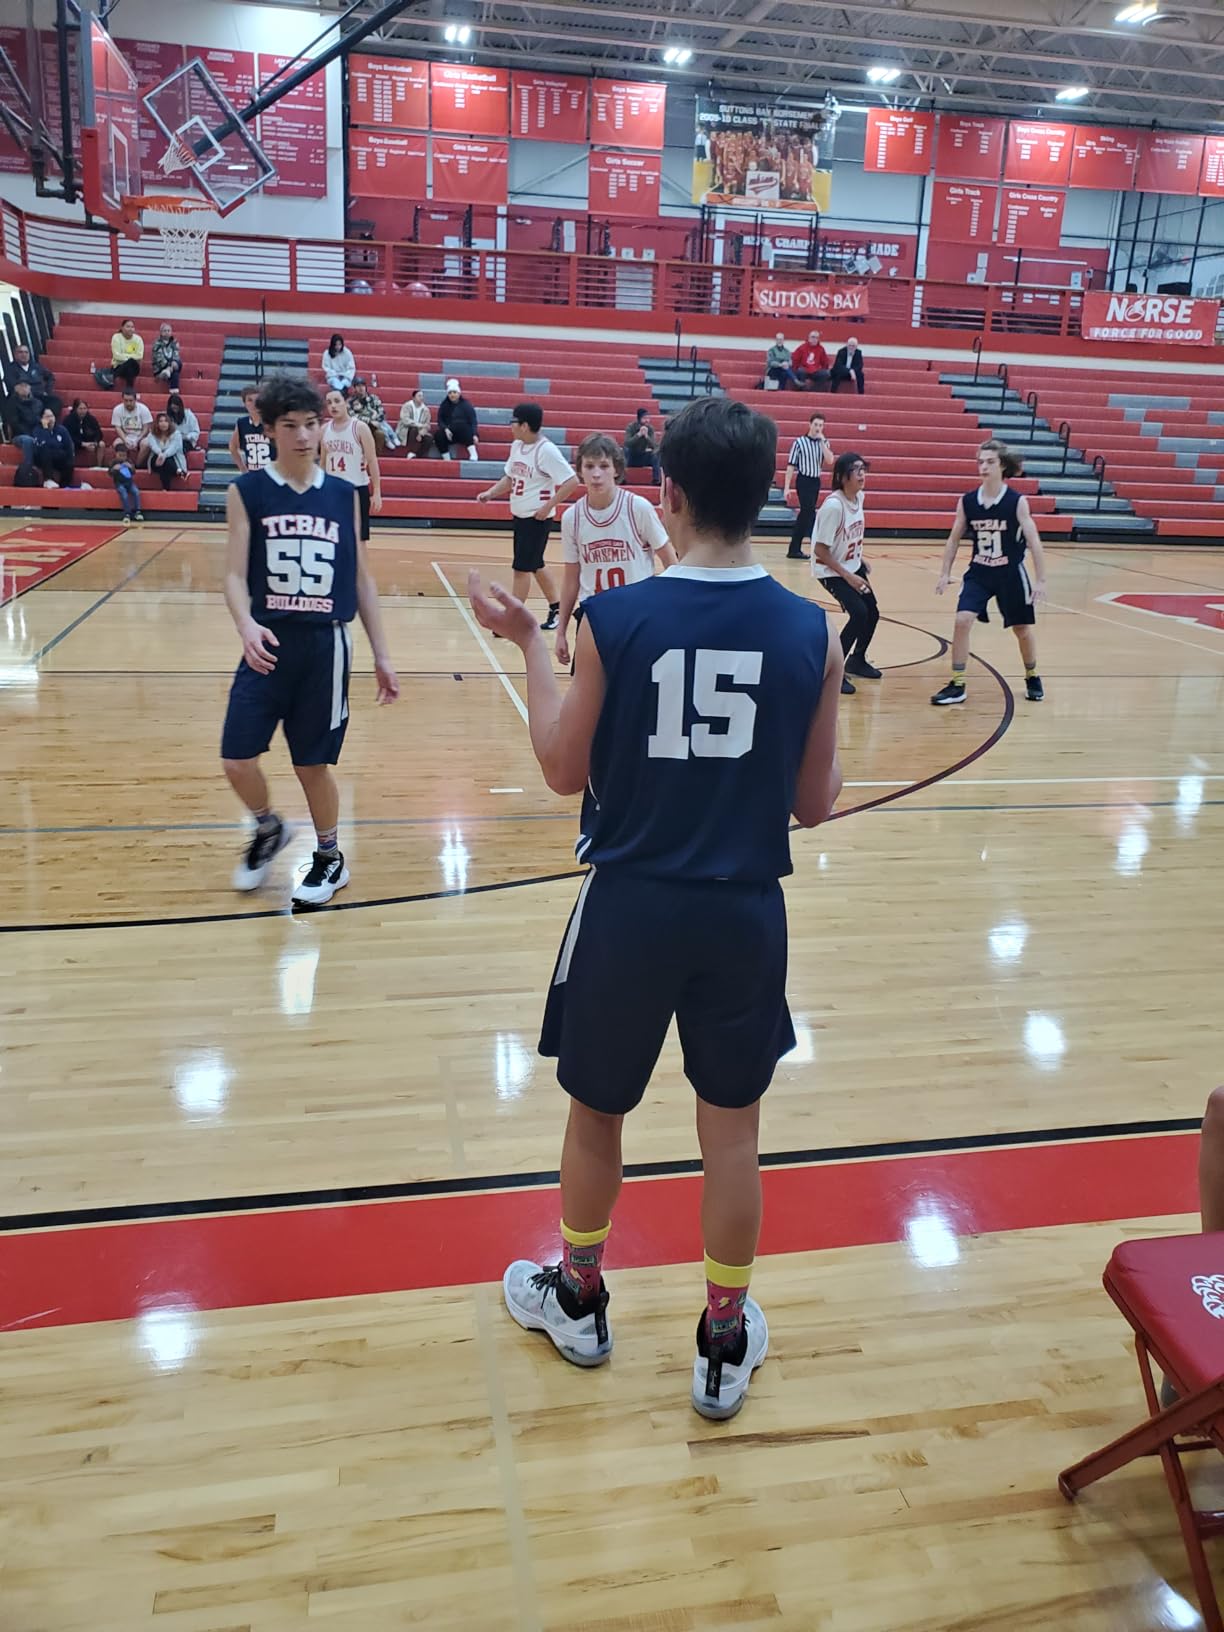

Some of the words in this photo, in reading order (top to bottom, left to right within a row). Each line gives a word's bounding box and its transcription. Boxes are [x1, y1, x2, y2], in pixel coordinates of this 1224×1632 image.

[759, 288, 829, 309] SUTTONS
[833, 293, 861, 310] BAY
[1091, 327, 1136, 339] FORCE
[1139, 328, 1163, 340] FOR
[1166, 329, 1203, 340] GOOD
[246, 443, 271, 465] 32
[331, 456, 346, 472] 14
[261, 513, 340, 544] TCBAA
[977, 530, 1003, 559] 21
[265, 538, 336, 596] 55
[594, 567, 625, 593] 10
[265, 594, 334, 613] BULLDOGS
[648, 648, 764, 760] 15
